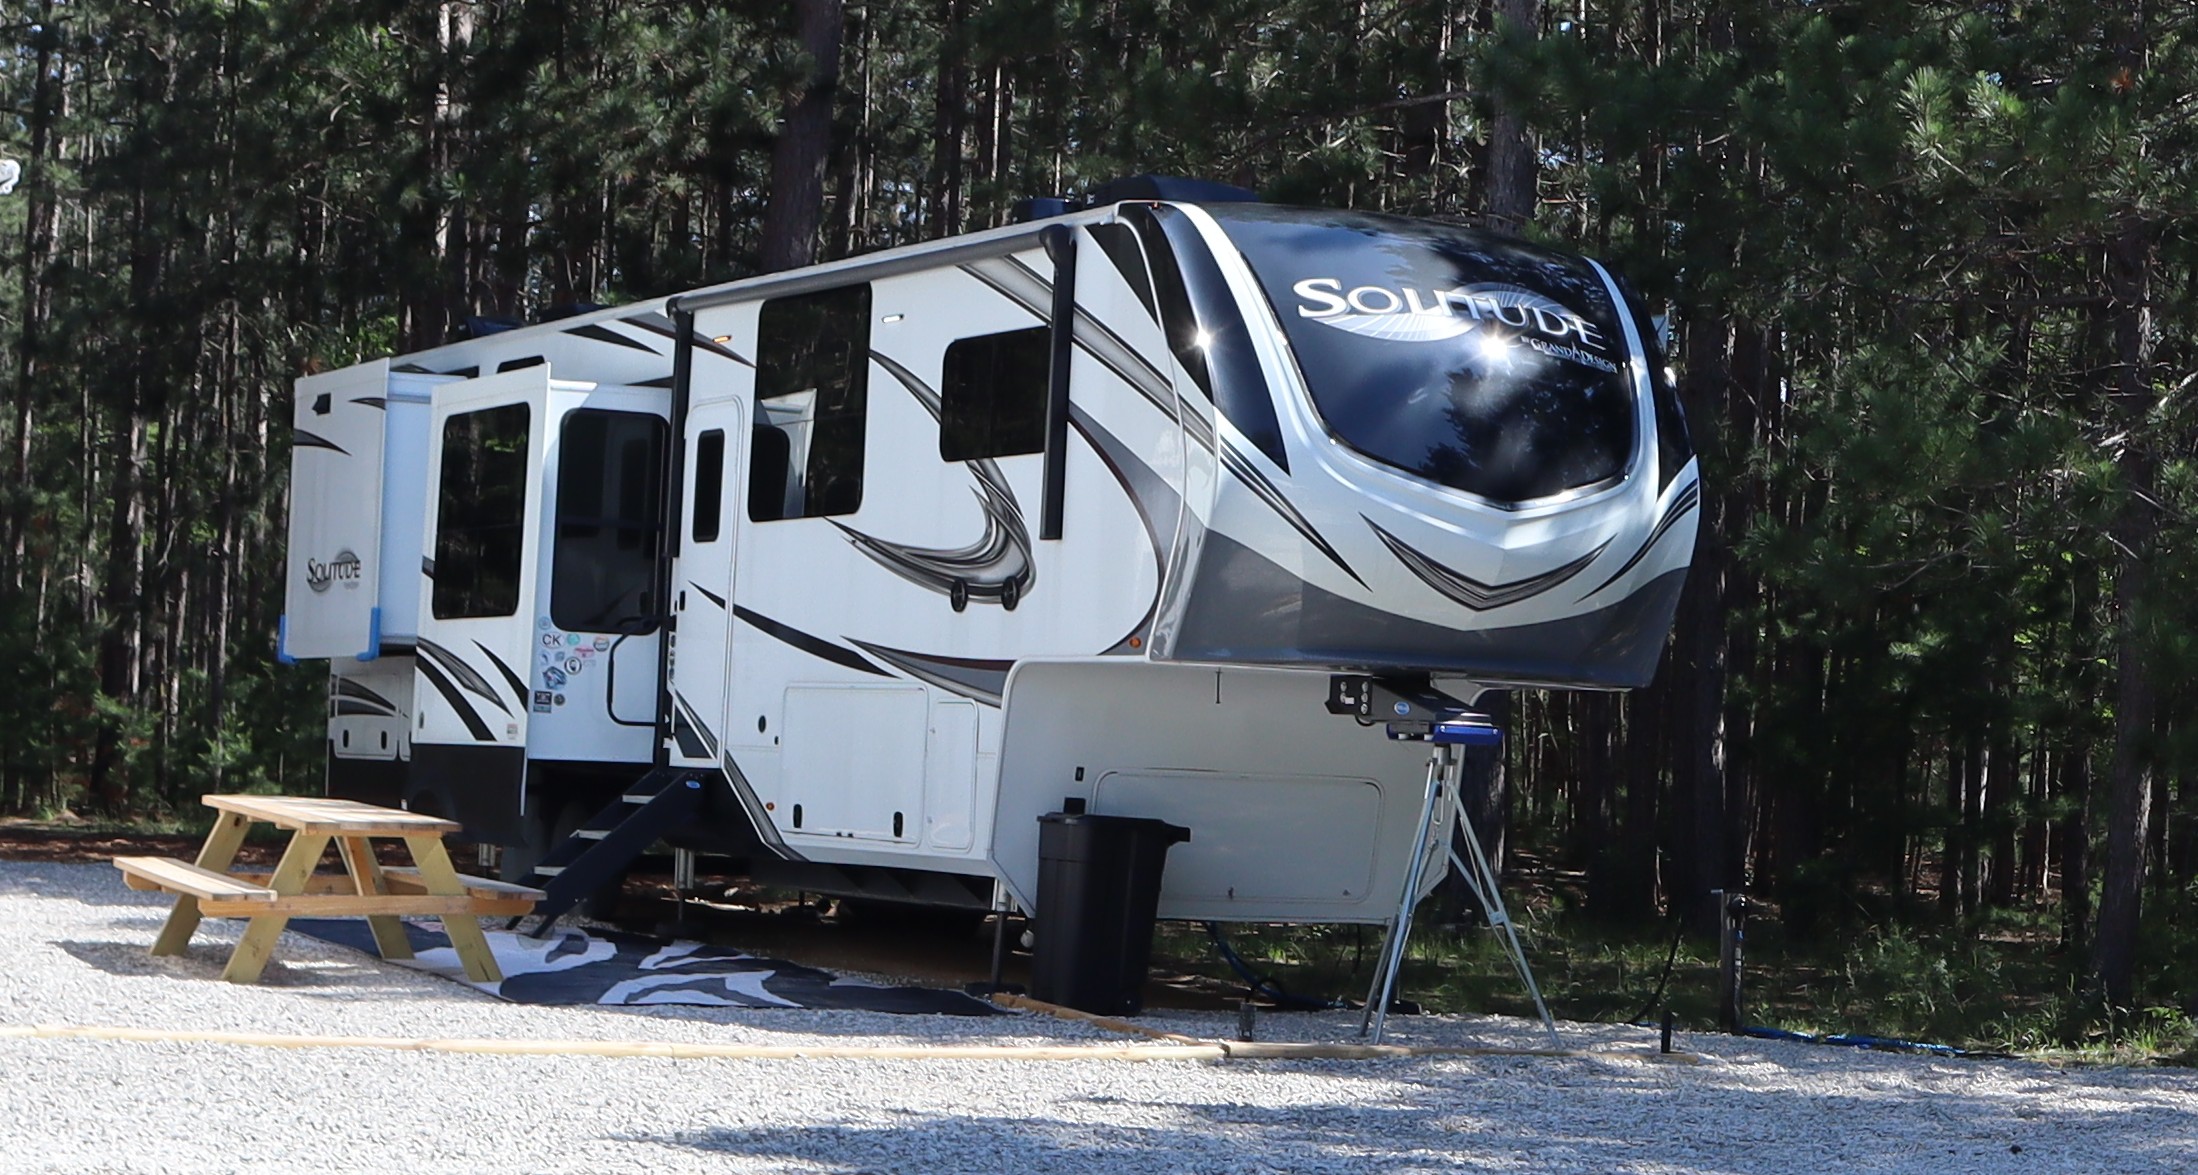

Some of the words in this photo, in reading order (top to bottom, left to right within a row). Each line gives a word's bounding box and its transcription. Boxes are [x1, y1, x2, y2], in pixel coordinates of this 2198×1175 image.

[1292, 277, 1607, 351] SOLITUDE
[306, 557, 361, 584] SOLITUDE
[542, 634, 561, 646] CK
